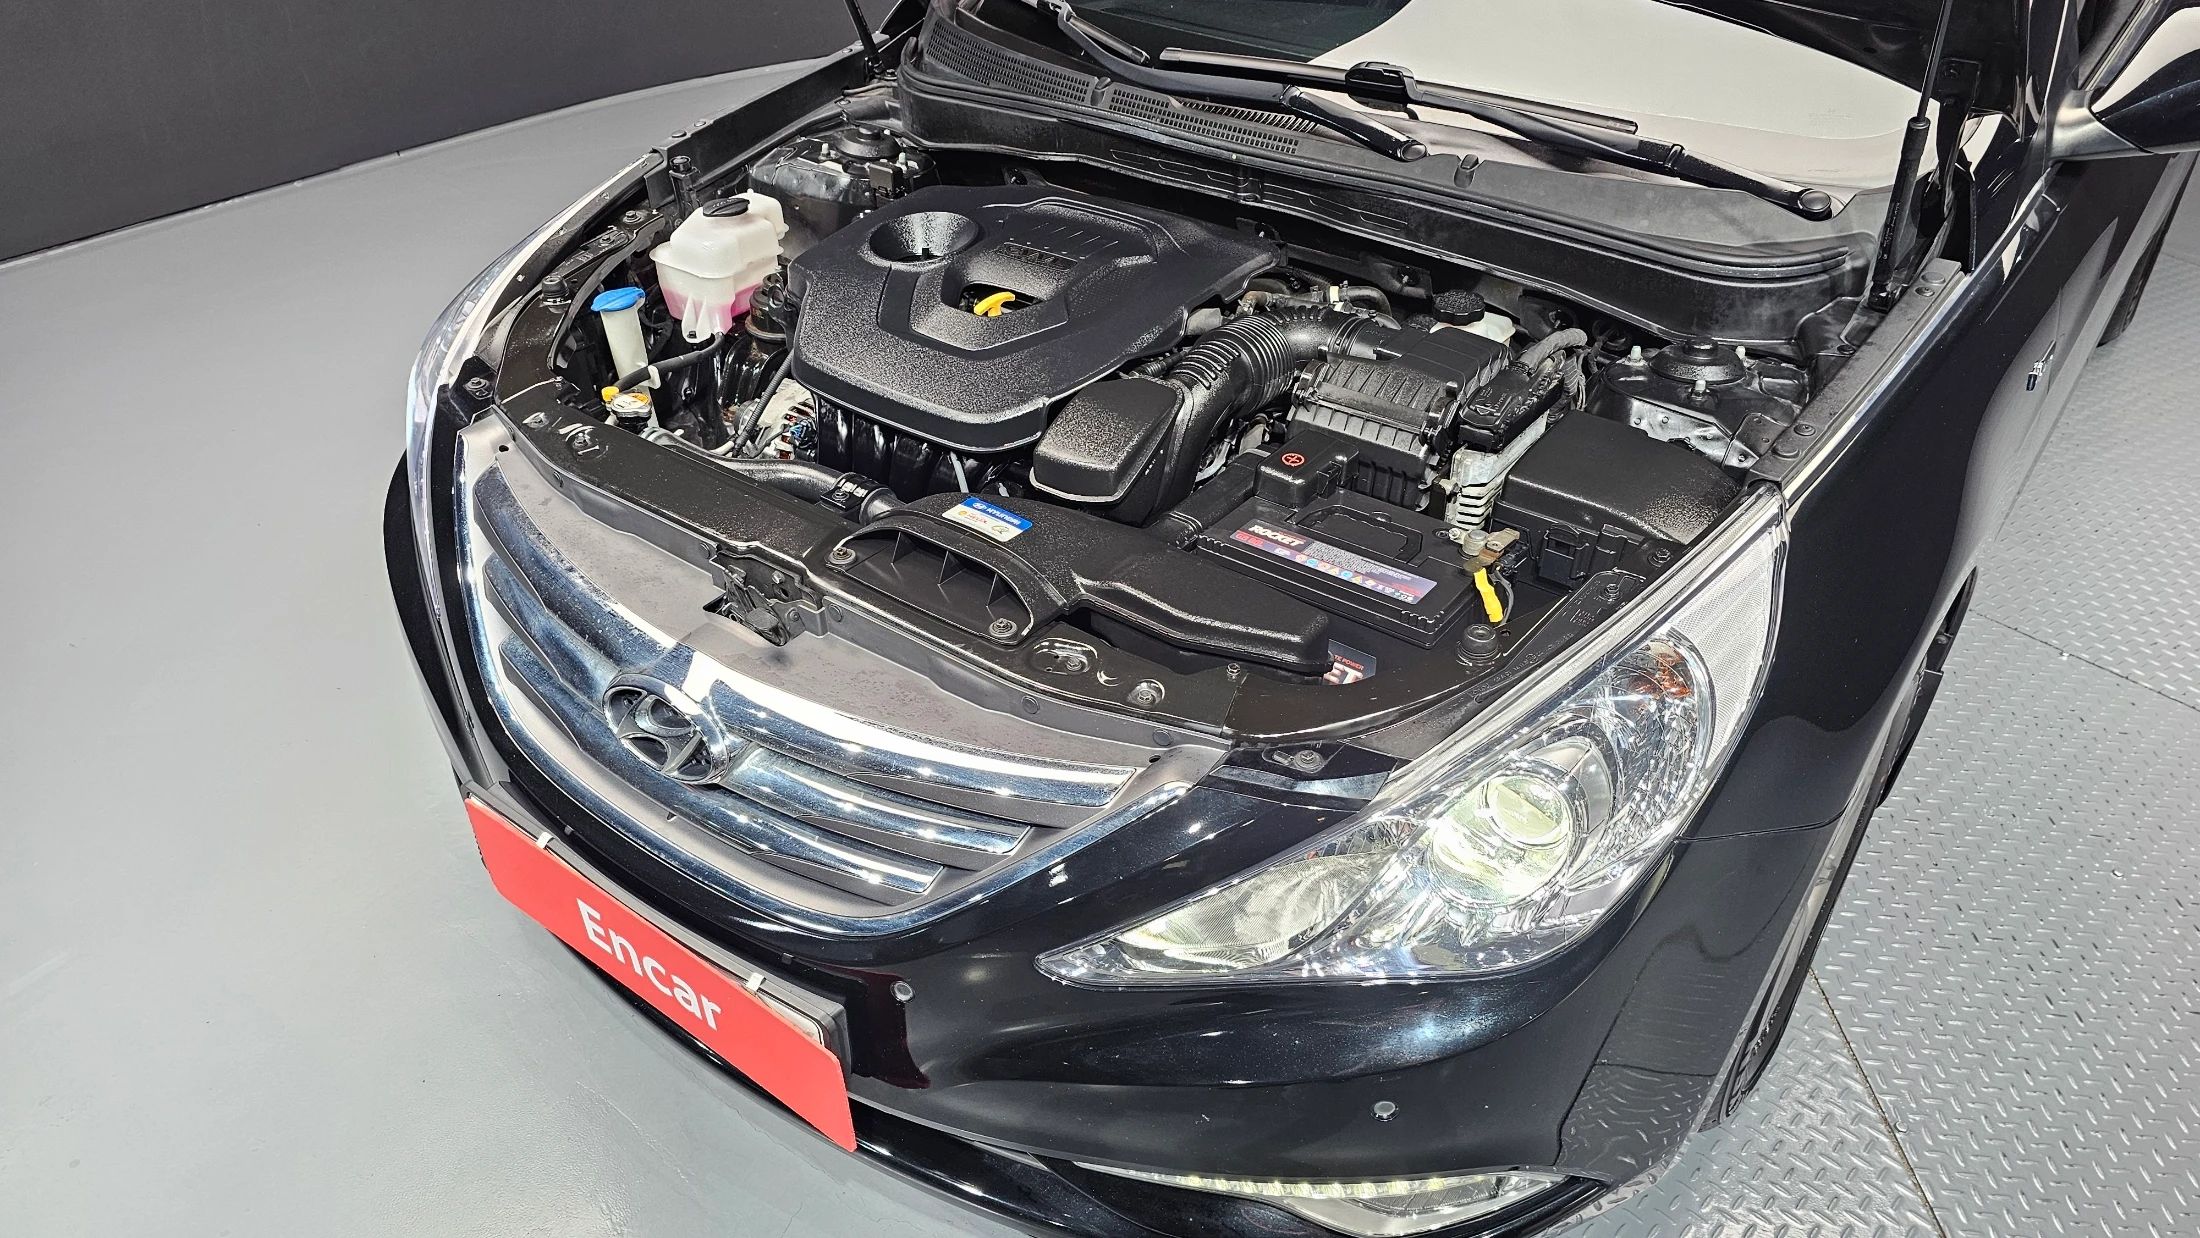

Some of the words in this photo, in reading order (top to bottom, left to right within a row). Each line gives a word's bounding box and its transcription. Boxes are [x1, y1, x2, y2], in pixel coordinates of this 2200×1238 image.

[985, 507, 1022, 526] HYUNDAI
[1248, 524, 1305, 547] ROCKET
[1341, 657, 1365, 671] POWER
[576, 897, 722, 1031] Encar
